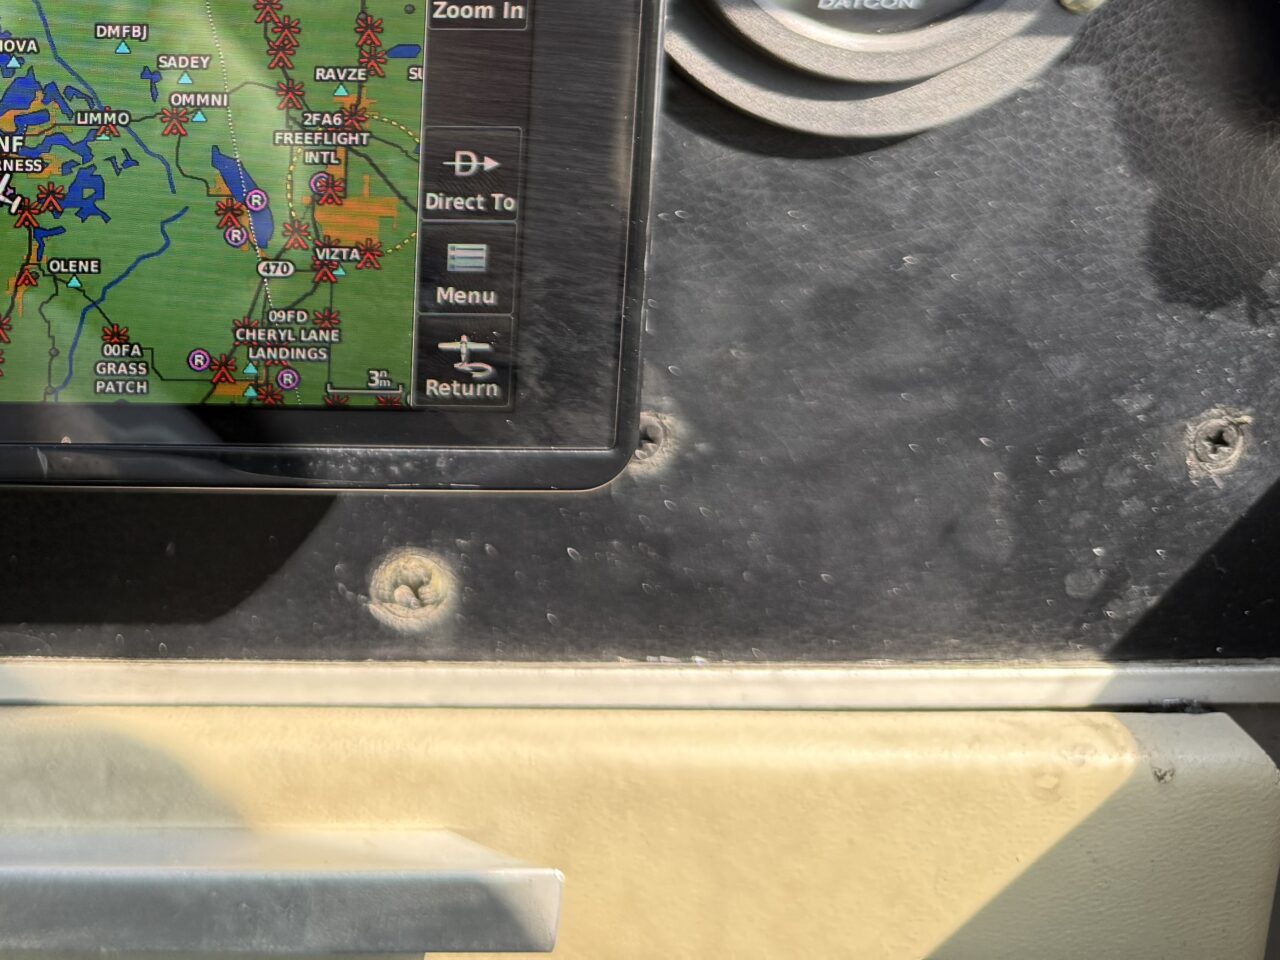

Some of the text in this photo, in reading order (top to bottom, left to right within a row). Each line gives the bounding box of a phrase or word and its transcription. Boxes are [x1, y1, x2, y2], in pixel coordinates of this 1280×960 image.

[432, 1, 525, 19] Zoom In
[96, 25, 148, 41] DMFBJ
[158, 55, 211, 69] SADEY
[315, 68, 368, 81] RAVZE
[170, 93, 229, 107] OMMNI
[303, 113, 342, 126] 2FA6
[273, 132, 371, 145] FREEFLIGHT
[304, 151, 340, 164] INTL
[425, 192, 517, 211] Direct To
[315, 247, 361, 261] VIZTA
[49, 260, 99, 272] OLENE
[262, 262, 290, 275] 470
[436, 287, 496, 305] Menu
[269, 309, 308, 323] 09FD
[235, 328, 340, 342] CHERYL LANE
[103, 343, 143, 357] 00FA
[248, 347, 329, 360] LANDINGS
[95, 362, 148, 376] GRASS
[95, 380, 148, 394] PATCH
[425, 379, 498, 397] Return
